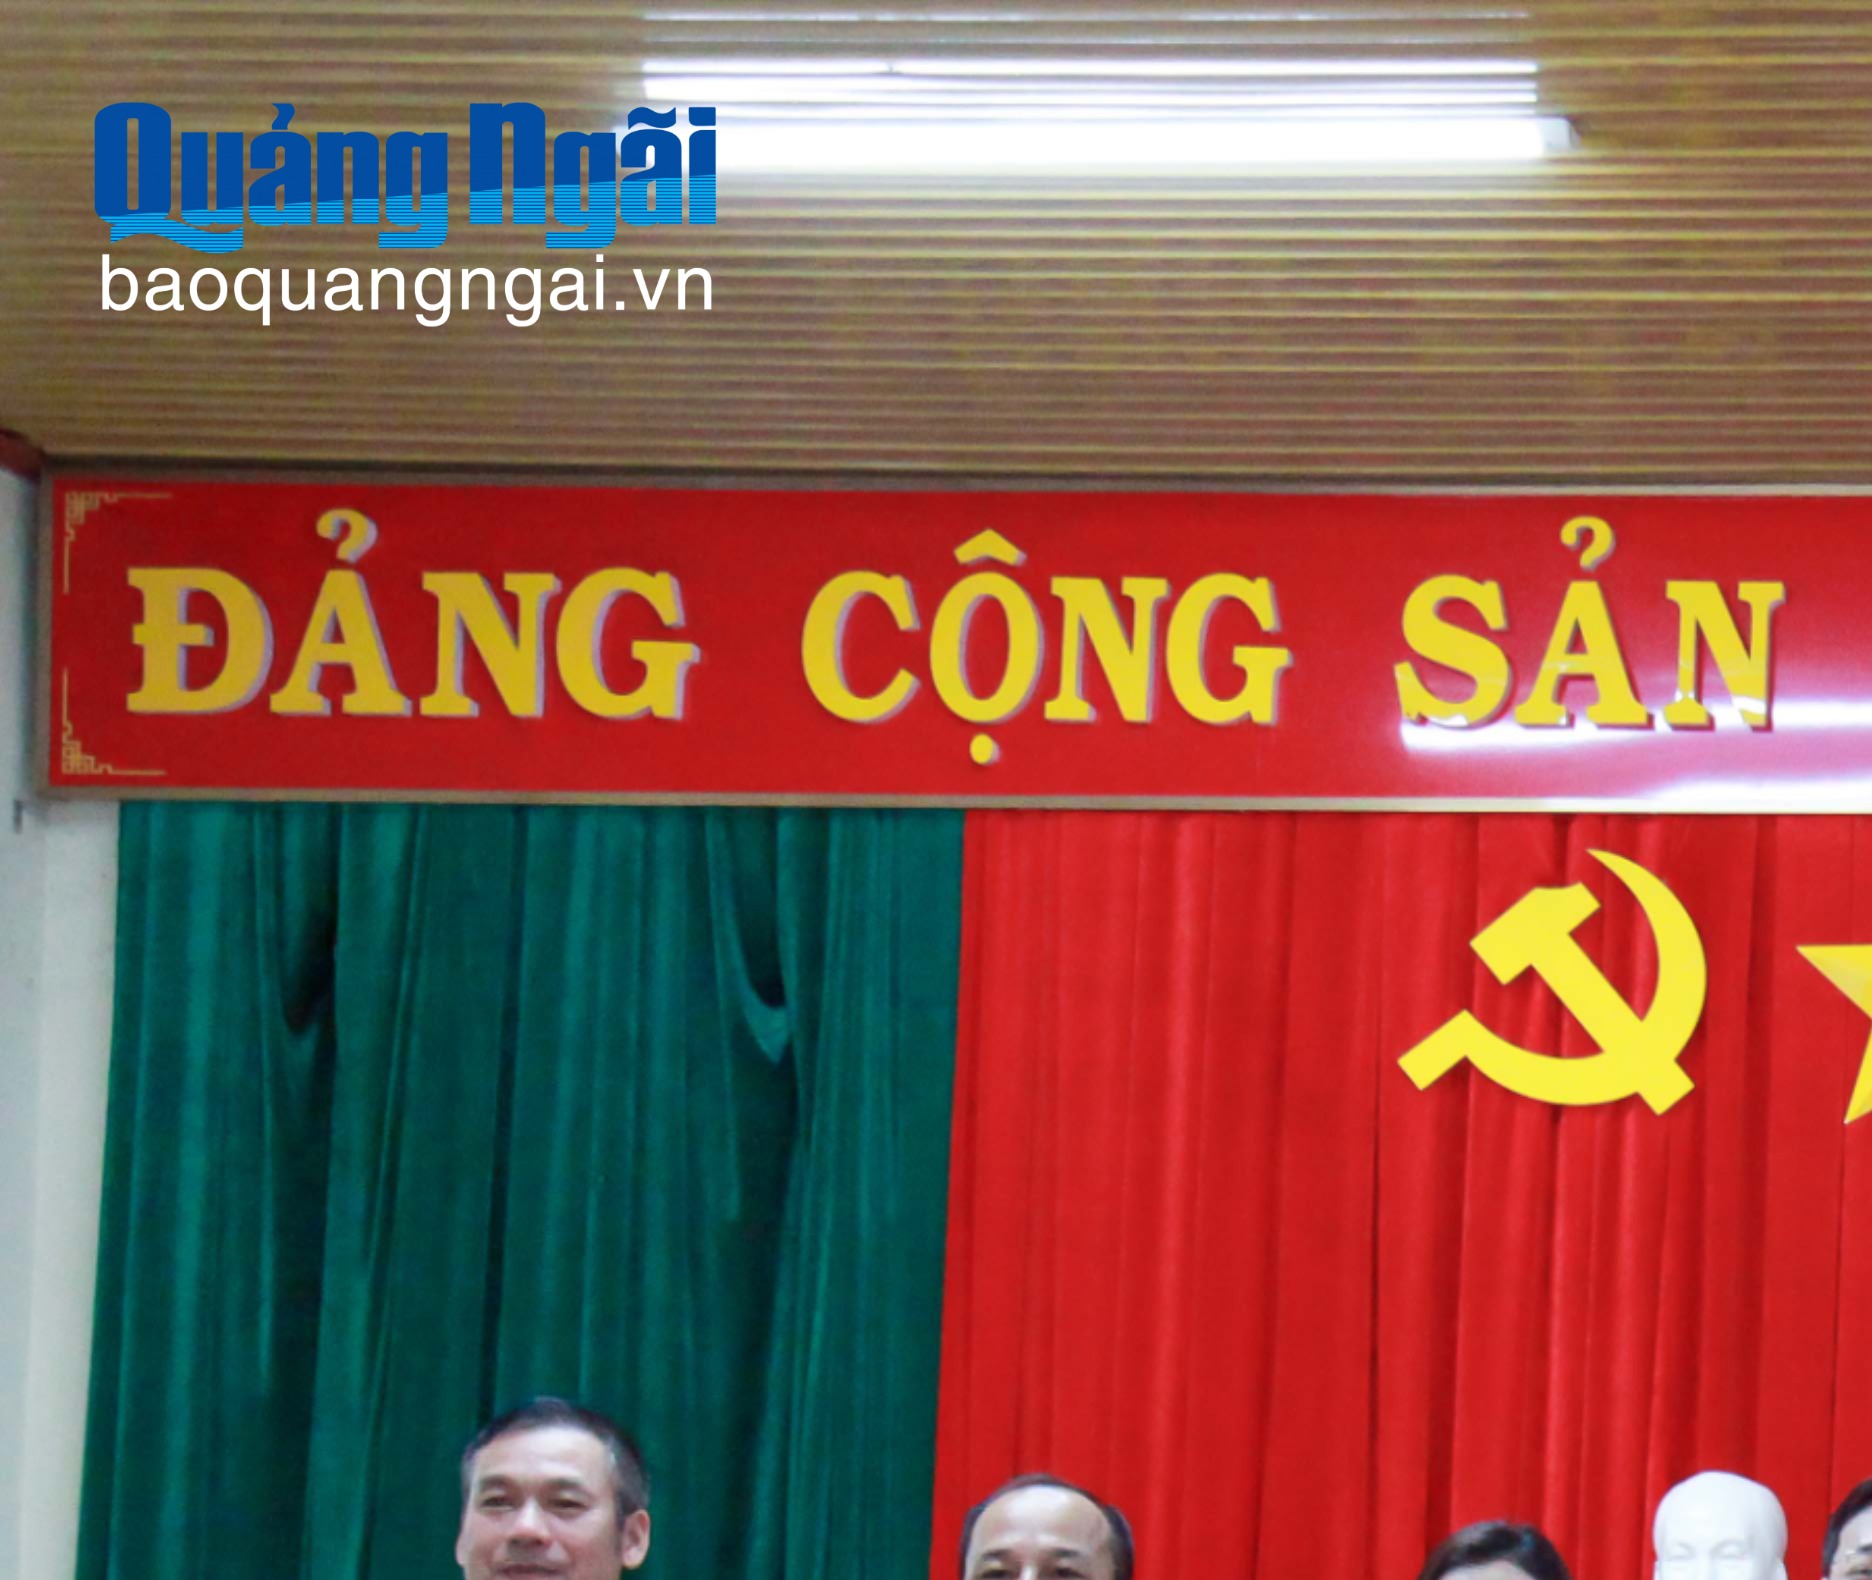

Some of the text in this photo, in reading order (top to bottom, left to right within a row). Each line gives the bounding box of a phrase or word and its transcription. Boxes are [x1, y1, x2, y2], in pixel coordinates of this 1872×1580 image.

[127, 509, 700, 719] ĐẢNG
[801, 528, 1293, 766] CỘNG
[1394, 516, 1788, 729] SẢN
